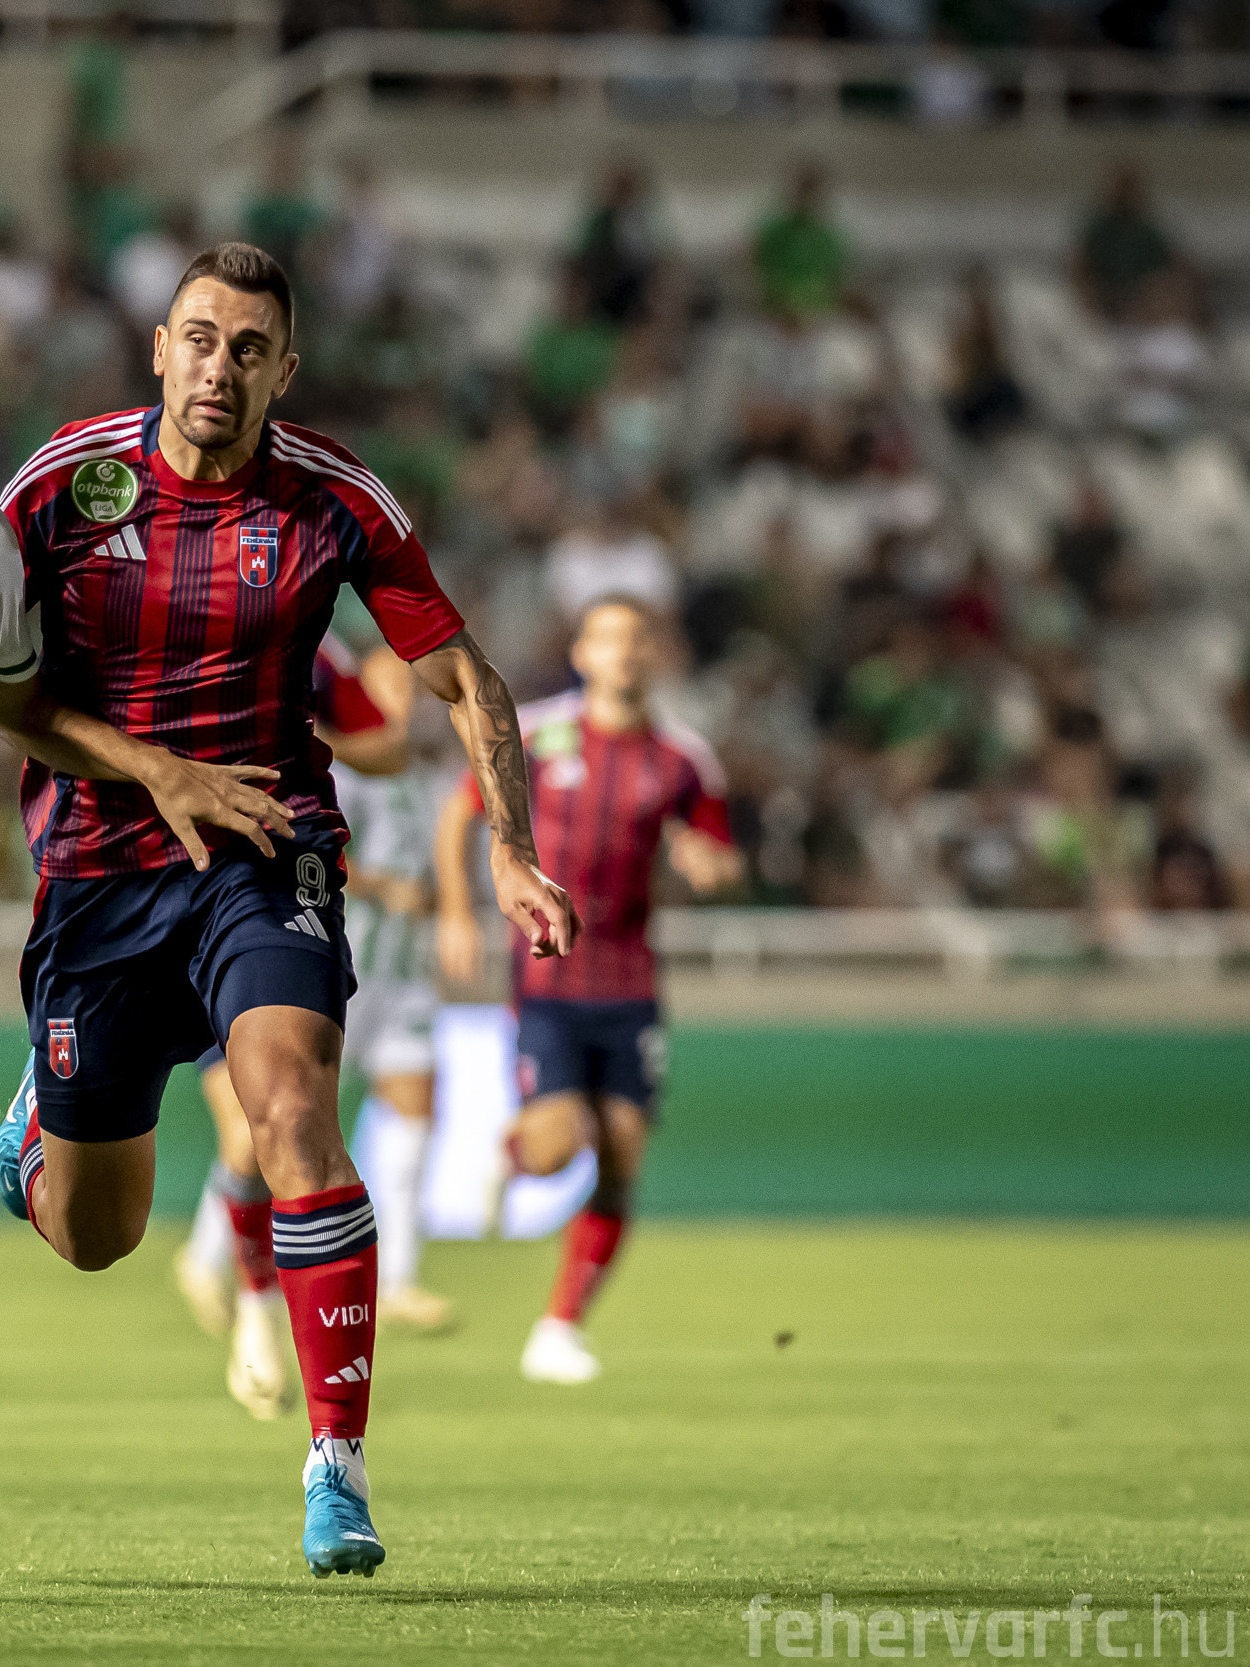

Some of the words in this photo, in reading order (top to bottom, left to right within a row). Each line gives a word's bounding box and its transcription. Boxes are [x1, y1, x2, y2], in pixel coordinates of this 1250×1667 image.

[76, 482, 132, 497] otpbank
[94, 504, 113, 513] LIGA
[296, 852, 330, 907] 9
[318, 1303, 369, 1328] VIDI
